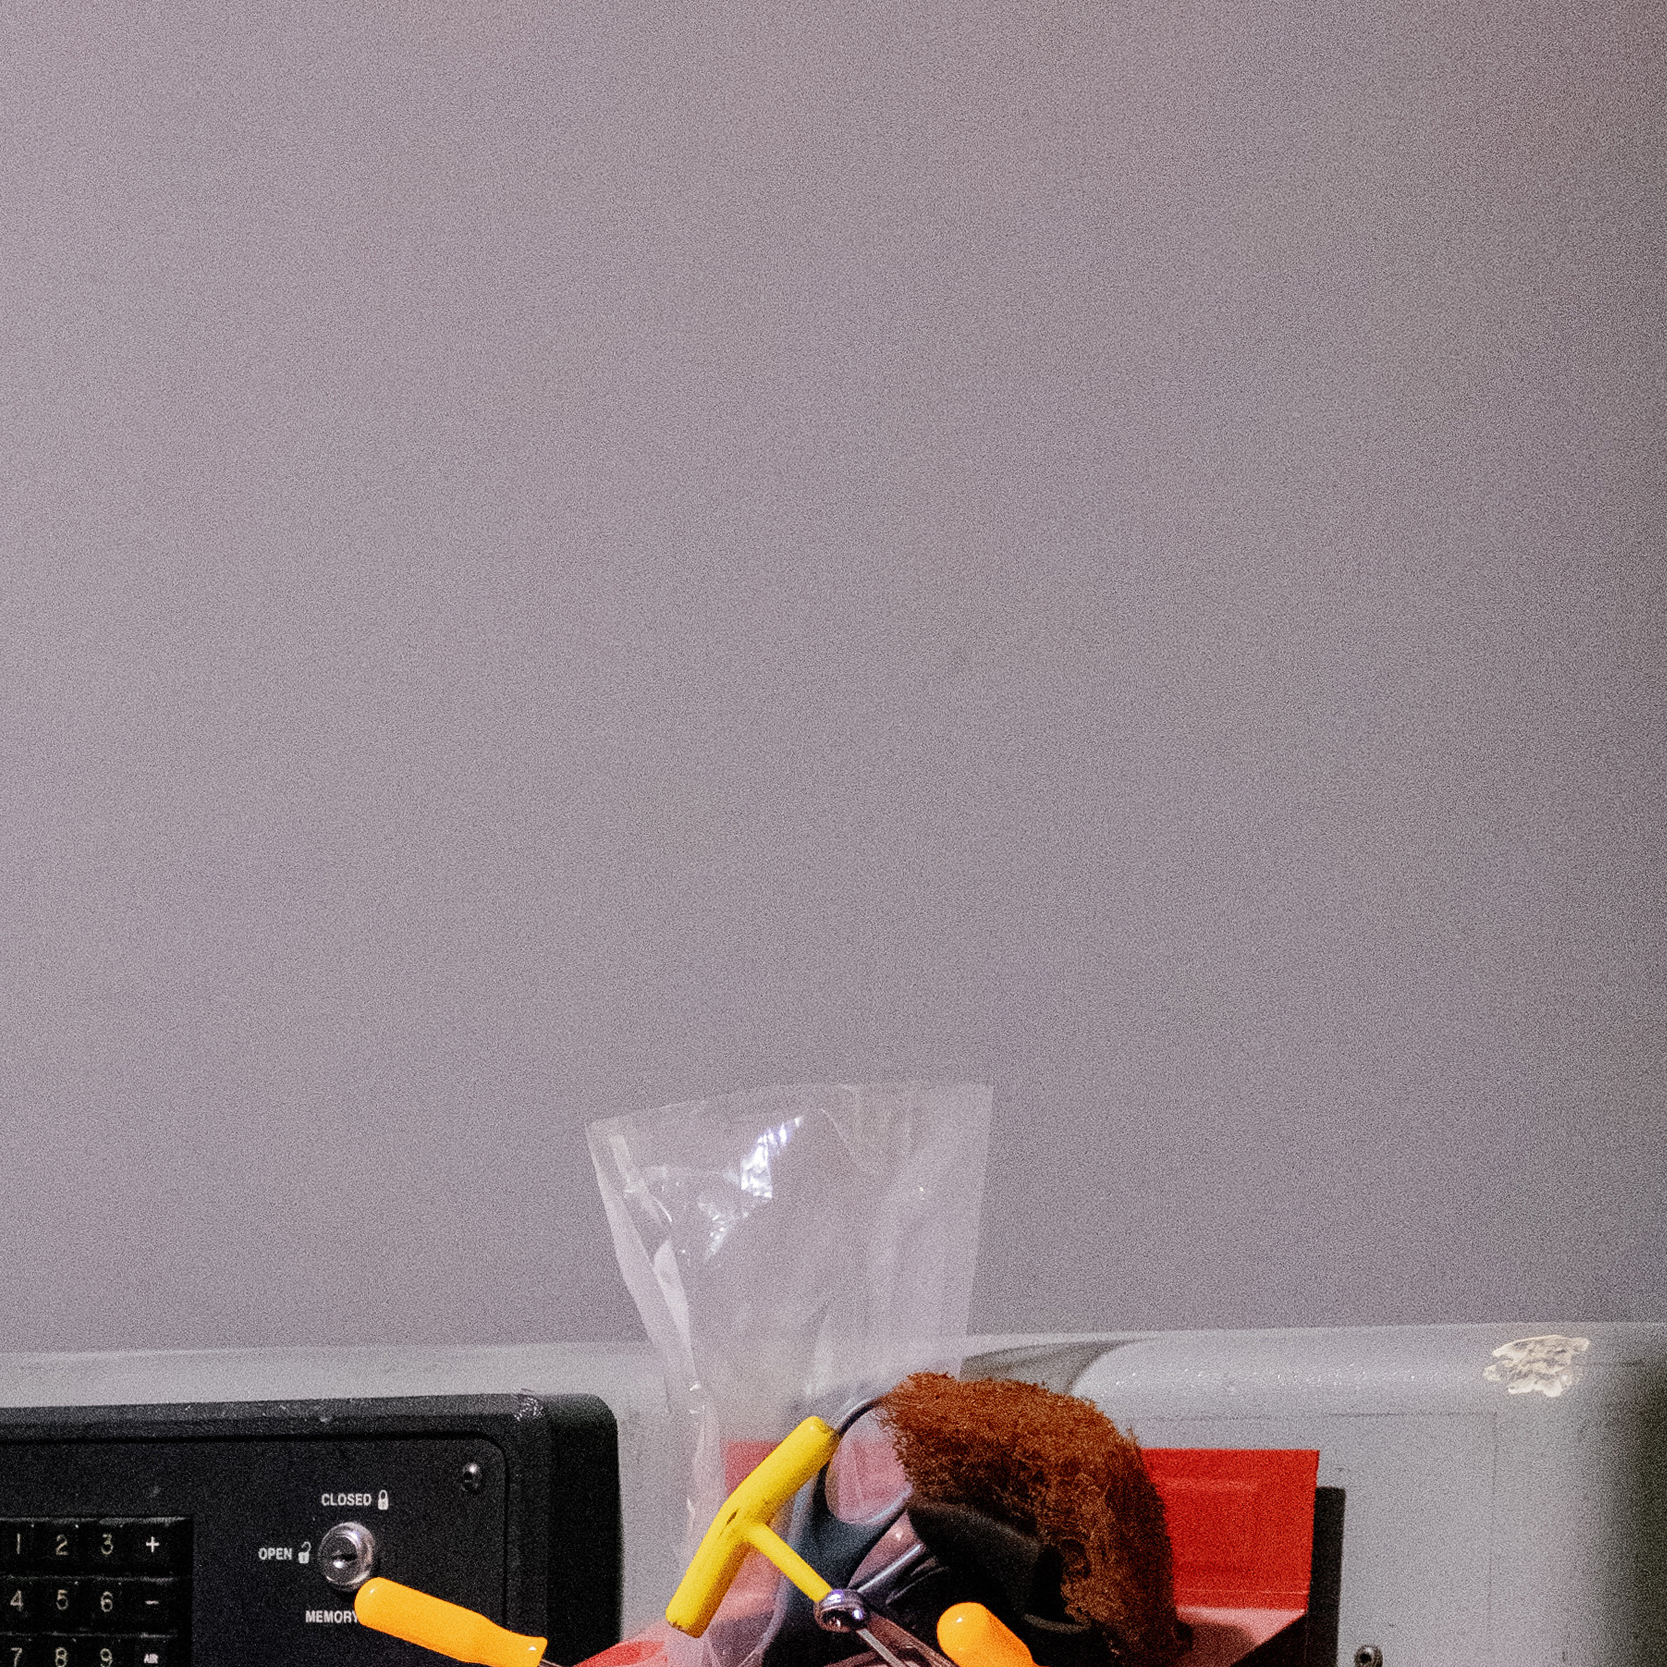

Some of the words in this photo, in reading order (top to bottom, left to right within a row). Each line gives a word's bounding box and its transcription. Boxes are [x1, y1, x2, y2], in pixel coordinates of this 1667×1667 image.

[321, 1492, 371, 1507] CLOSED
[15, 1533, 21, 1555] 1
[55, 1533, 69, 1556] 2
[101, 1533, 115, 1556] 3
[258, 1547, 293, 1561] OPEN
[9, 1589, 23, 1613] 4
[56, 1589, 69, 1611] 5
[99, 1590, 114, 1612] 6
[143, 1652, 160, 1665] AIR
